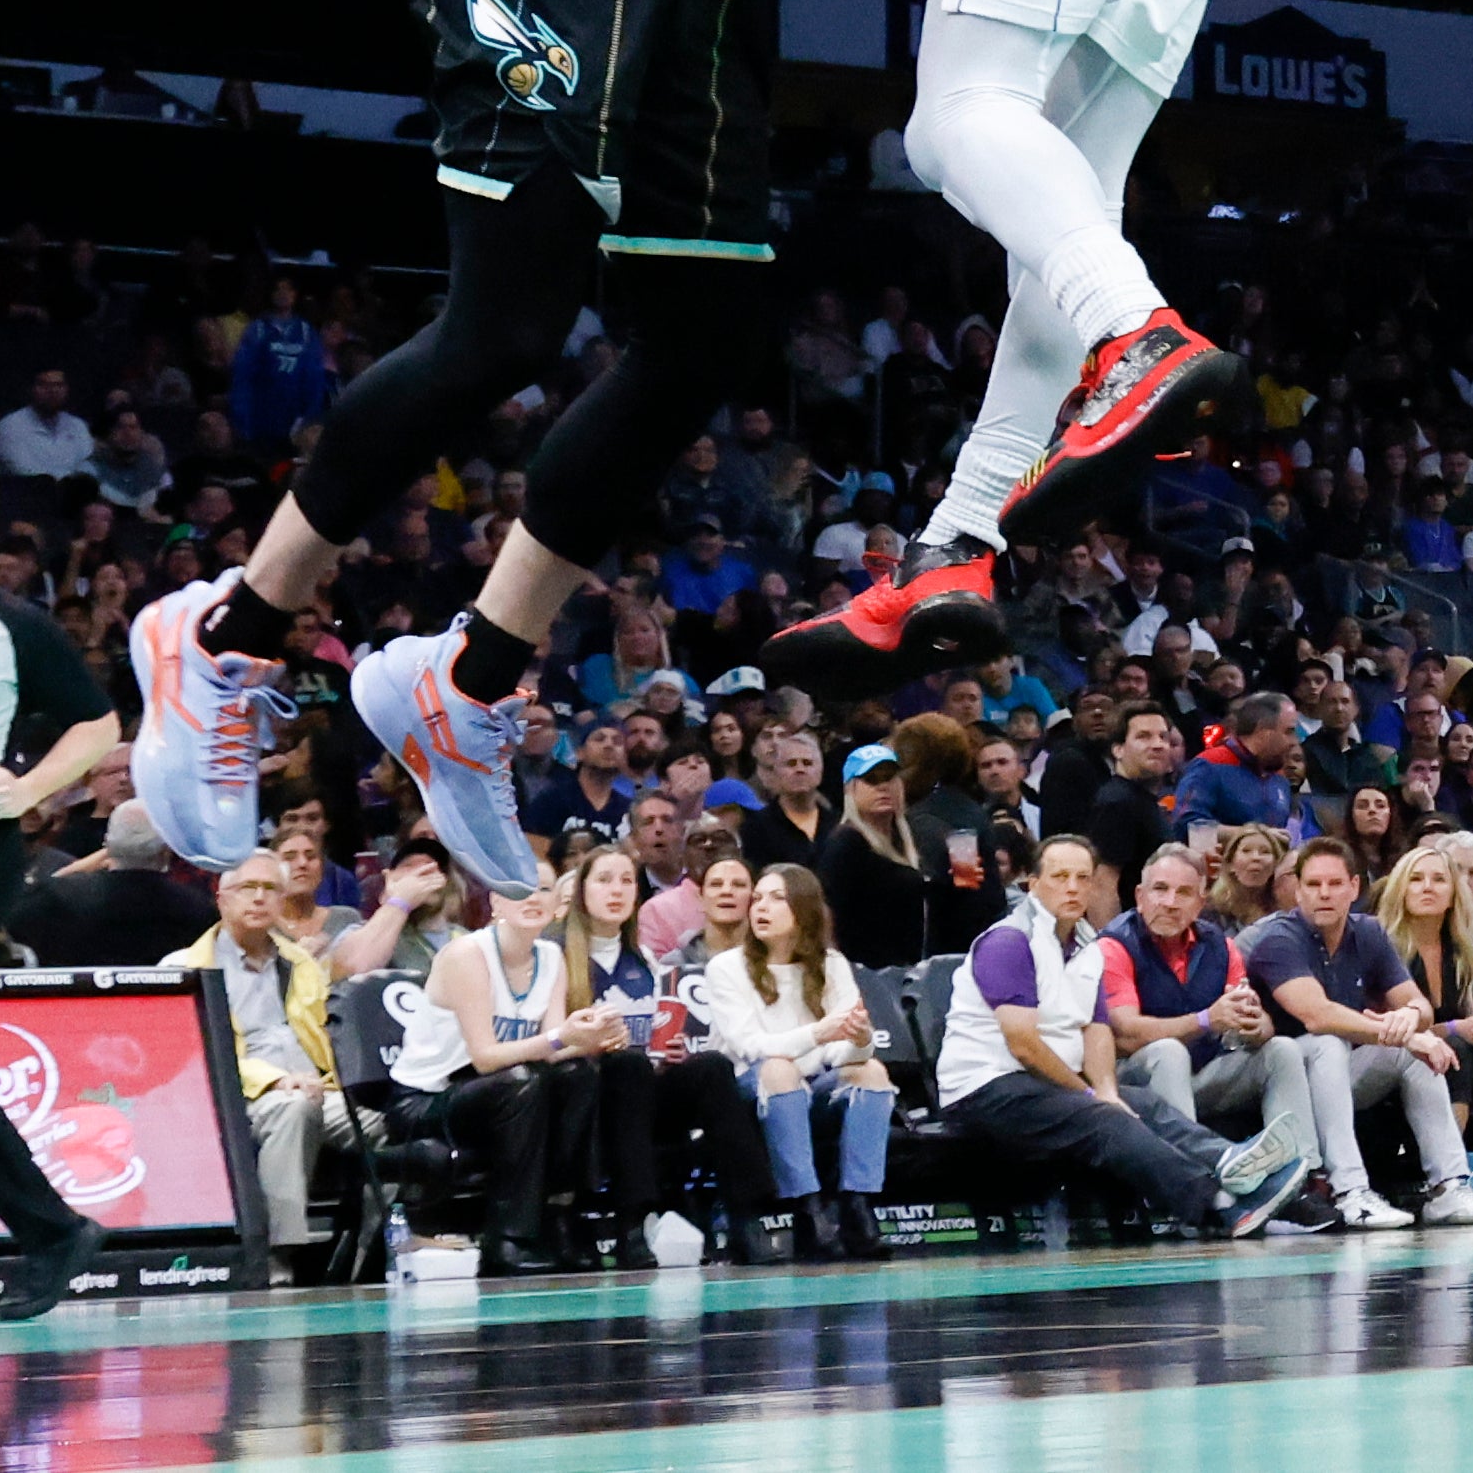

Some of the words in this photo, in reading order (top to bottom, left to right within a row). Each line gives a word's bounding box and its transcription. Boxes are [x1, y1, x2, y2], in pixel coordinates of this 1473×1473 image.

[1215, 39, 1368, 110] LOWE'S
[873, 1204, 935, 1221] UTILITY
[897, 1217, 976, 1232] INNOVATION
